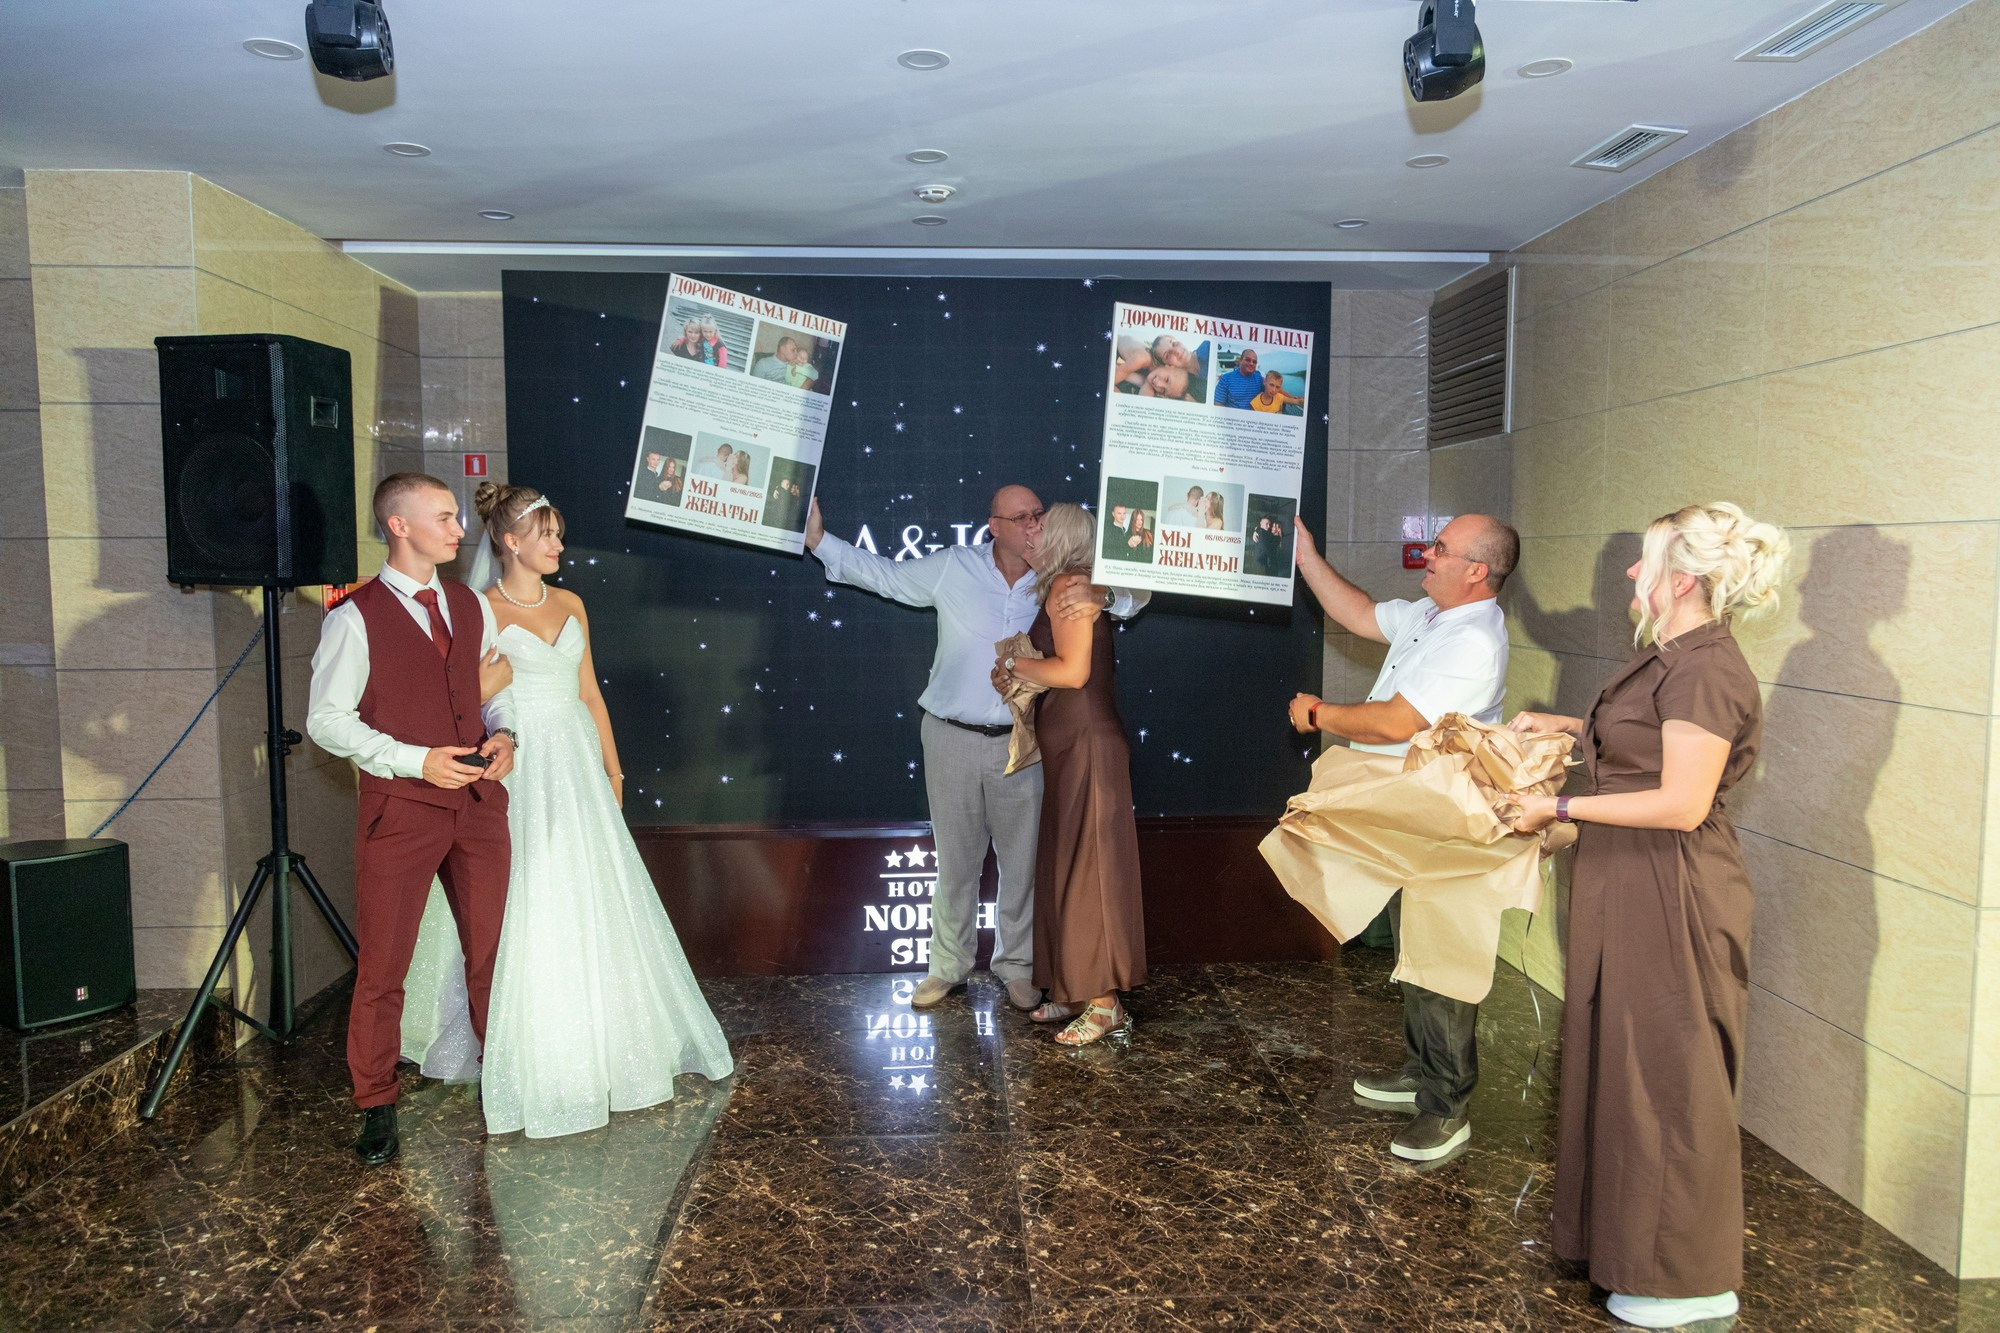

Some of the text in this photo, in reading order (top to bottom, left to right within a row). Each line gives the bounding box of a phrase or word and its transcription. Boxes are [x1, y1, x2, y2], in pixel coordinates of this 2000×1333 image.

[671, 277, 843, 337] ДОРОГИЕ МАМА И ПАПА!
[1120, 308, 1310, 350] ДОРОГИЕ МАМА И ПАПА!
[688, 478, 719, 498] МЫ
[685, 495, 759, 524] ЖЕНАТЫ!
[1159, 529, 1192, 548] МЫ
[1158, 549, 1239, 573] ЖЕНАТЫ!
[863, 902, 997, 932] NORH
